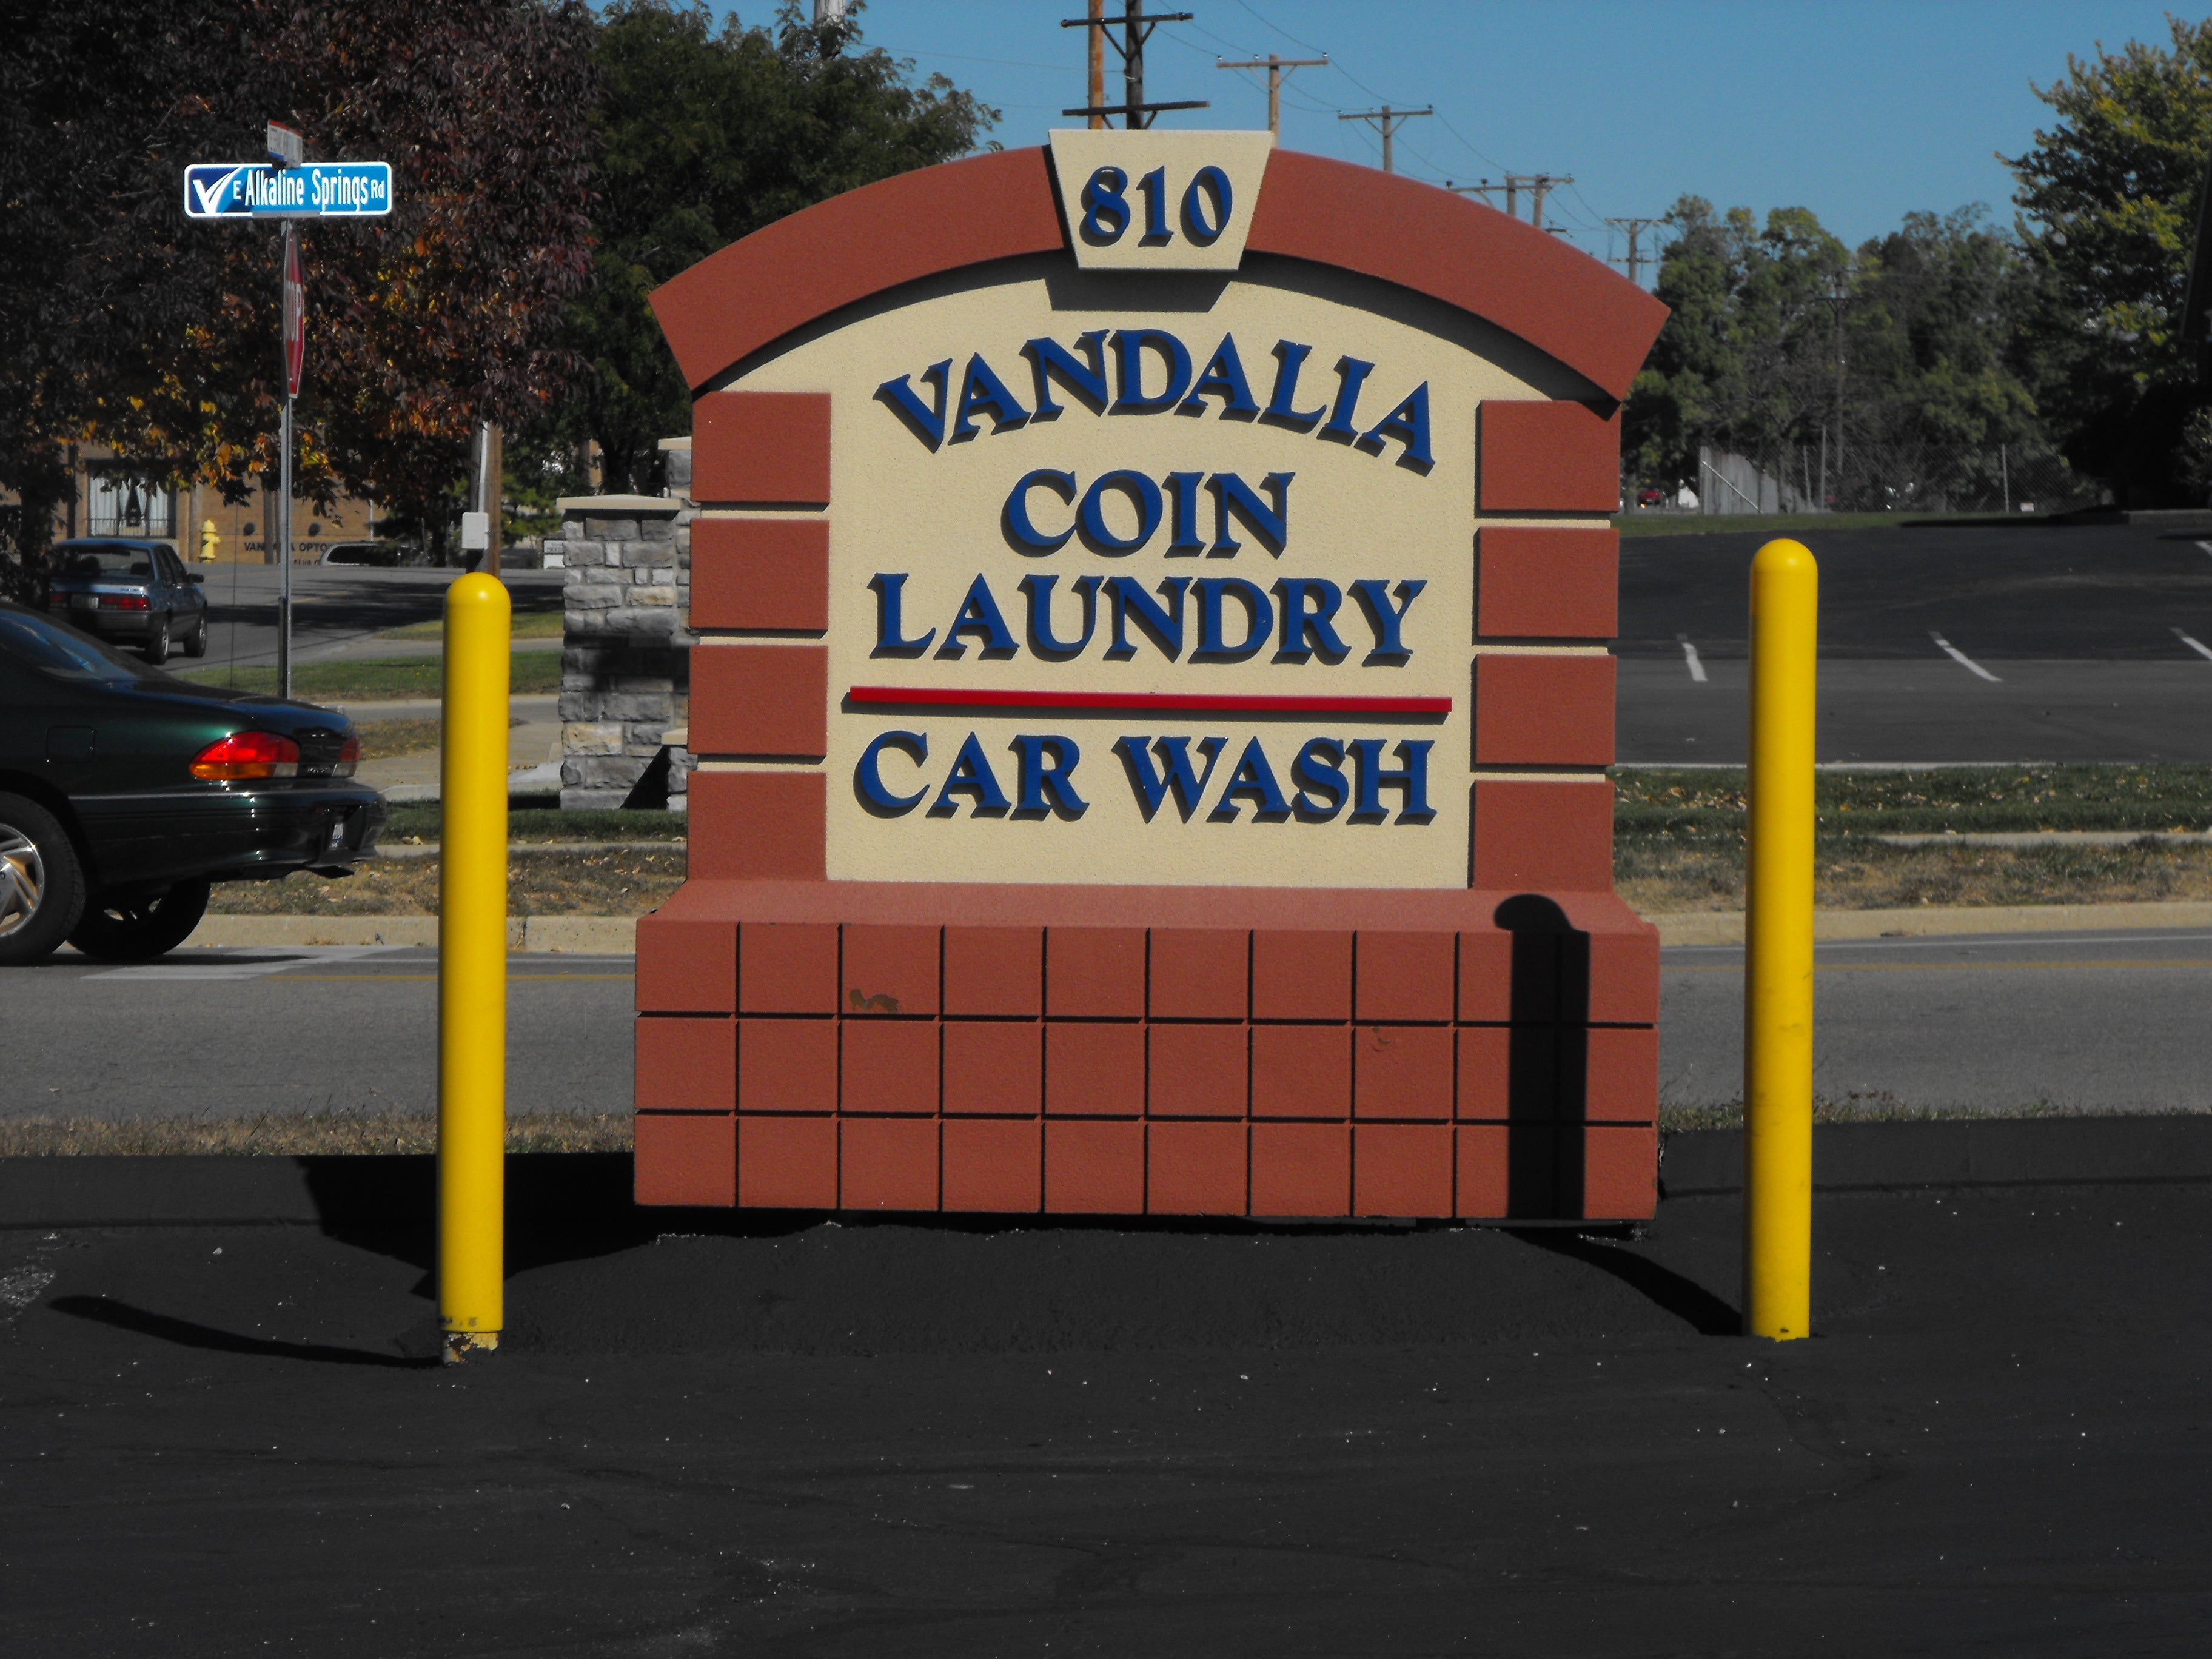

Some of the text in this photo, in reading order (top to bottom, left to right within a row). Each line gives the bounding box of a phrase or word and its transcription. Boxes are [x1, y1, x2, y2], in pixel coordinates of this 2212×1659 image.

[233, 168, 384, 212] E Alkaline Springs Rd
[1079, 165, 1233, 249] 810
[873, 329, 1435, 477] VANDALIA
[1003, 469, 1293, 558] COIN
[868, 574, 1427, 666] LAUNDRY
[854, 731, 1435, 825] CAR WASH
